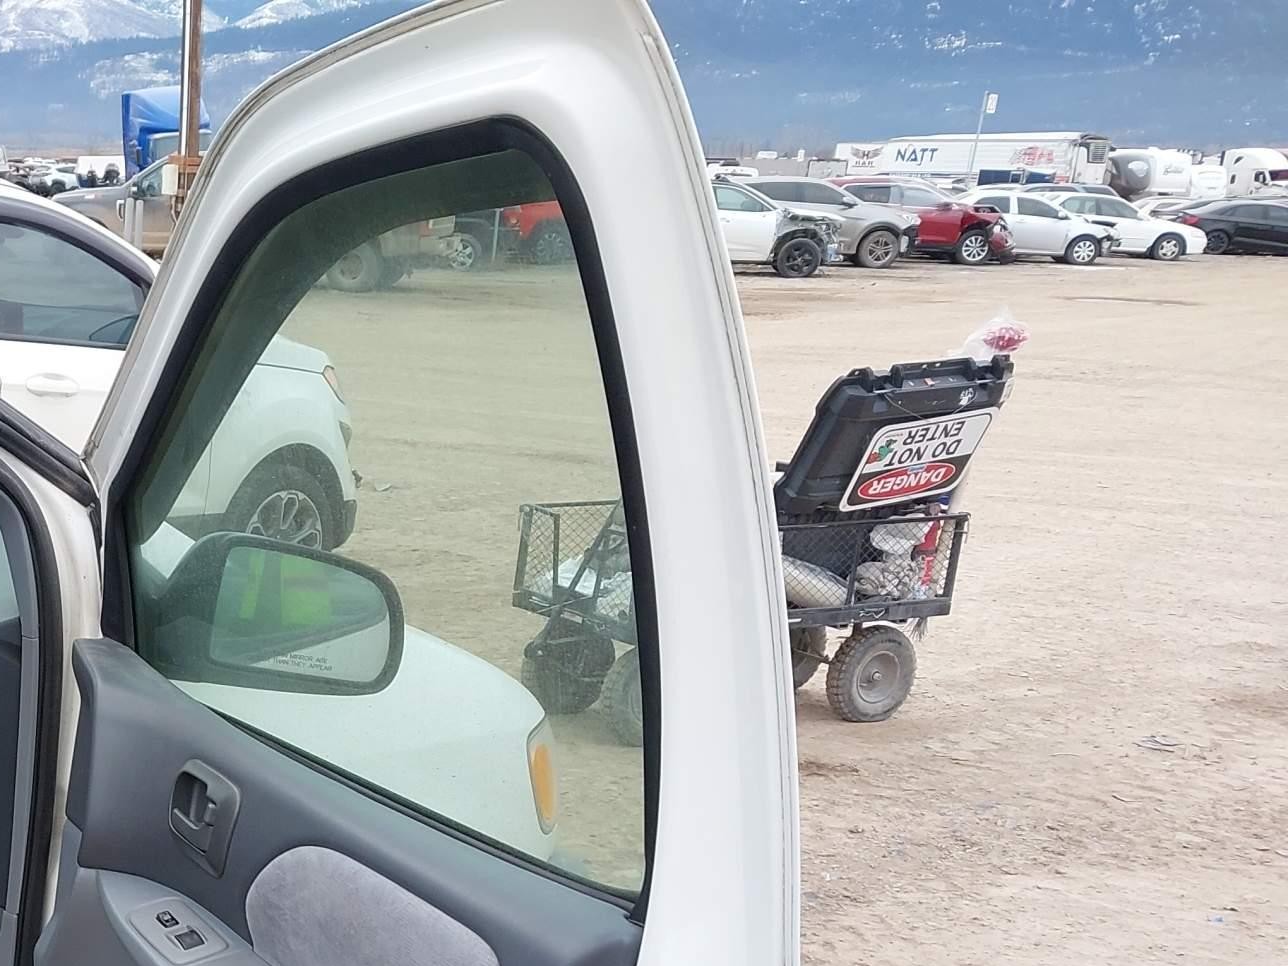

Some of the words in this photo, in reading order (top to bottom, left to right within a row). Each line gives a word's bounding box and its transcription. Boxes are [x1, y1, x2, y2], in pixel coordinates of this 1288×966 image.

[895, 148, 938, 166] NATT
[903, 420, 966, 446] ENTER
[884, 446, 929, 467] NOT
[931, 438, 963, 457] DO
[868, 467, 946, 495] DANGER
